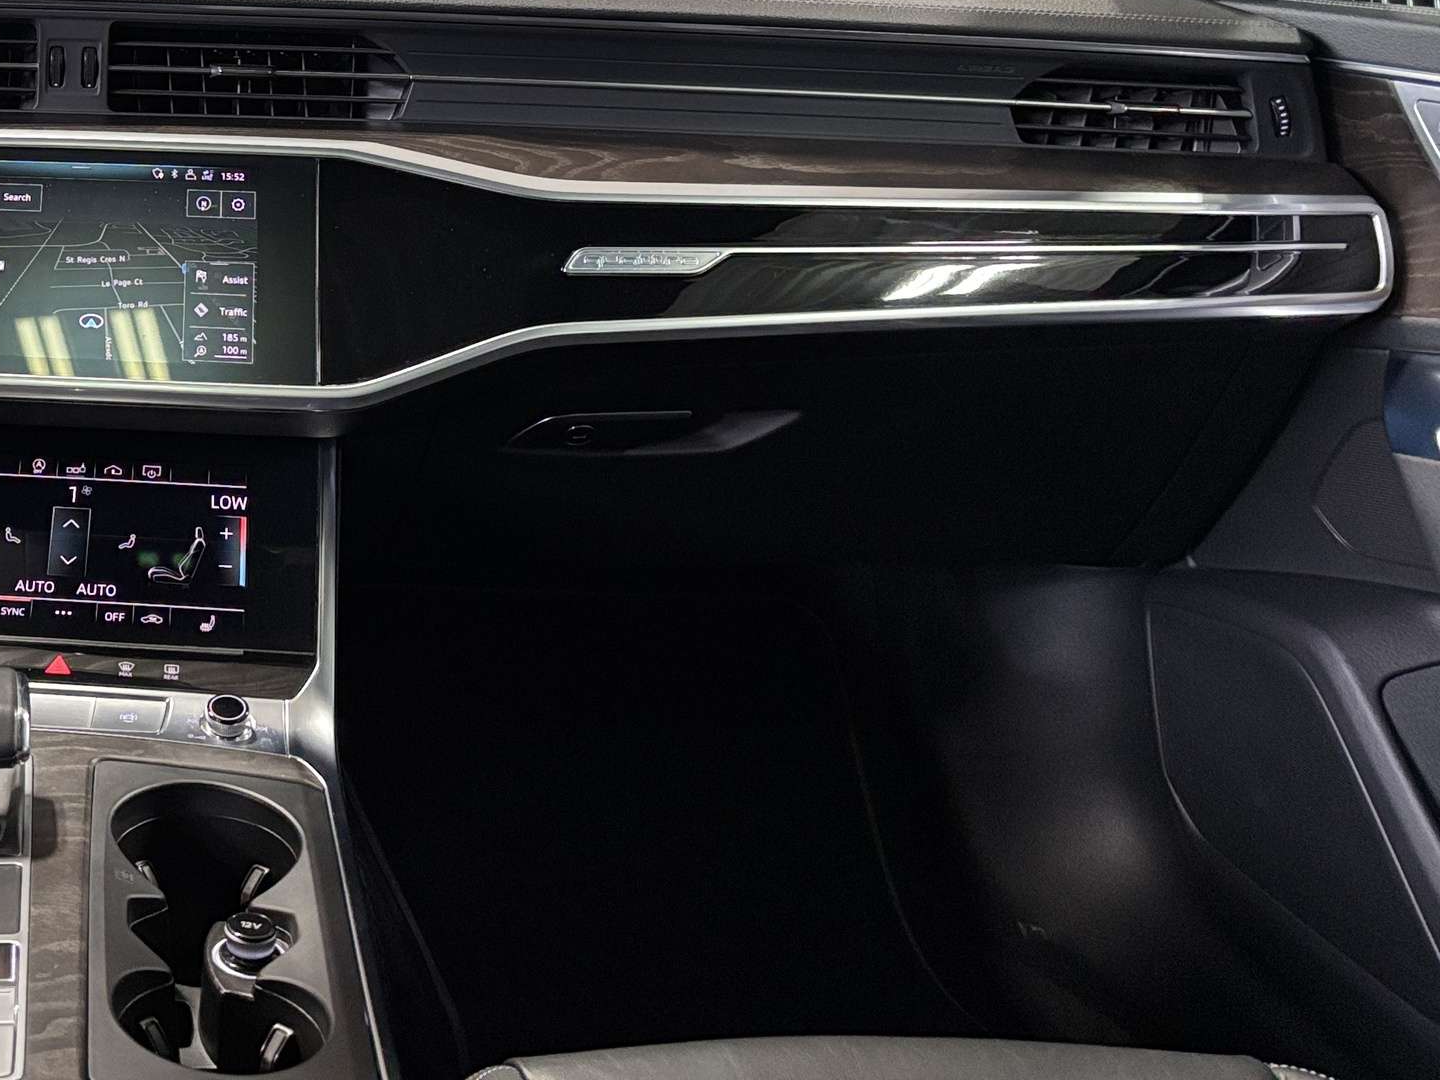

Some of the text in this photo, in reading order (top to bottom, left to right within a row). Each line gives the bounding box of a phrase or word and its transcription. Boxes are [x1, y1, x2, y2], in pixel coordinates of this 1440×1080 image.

[220, 172, 245, 181] 15:52
[3, 192, 32, 202] Search
[65, 256, 74, 264] St
[77, 256, 97, 265] Regis
[113, 279, 132, 288] Page
[222, 275, 248, 285] Assist
[138, 300, 148, 308] Rd
[219, 307, 248, 318] Traffic
[222, 333, 239, 343] 185
[222, 345, 247, 356] 100 m
[68, 486, 77, 503] 1
[211, 495, 247, 511] LOW
[14, 580, 55, 594] AUTO
[76, 583, 117, 597] AUTO
[0, 607, 26, 617] SYNC
[104, 612, 126, 623] OFF
[240, 920, 263, 930] 12V
